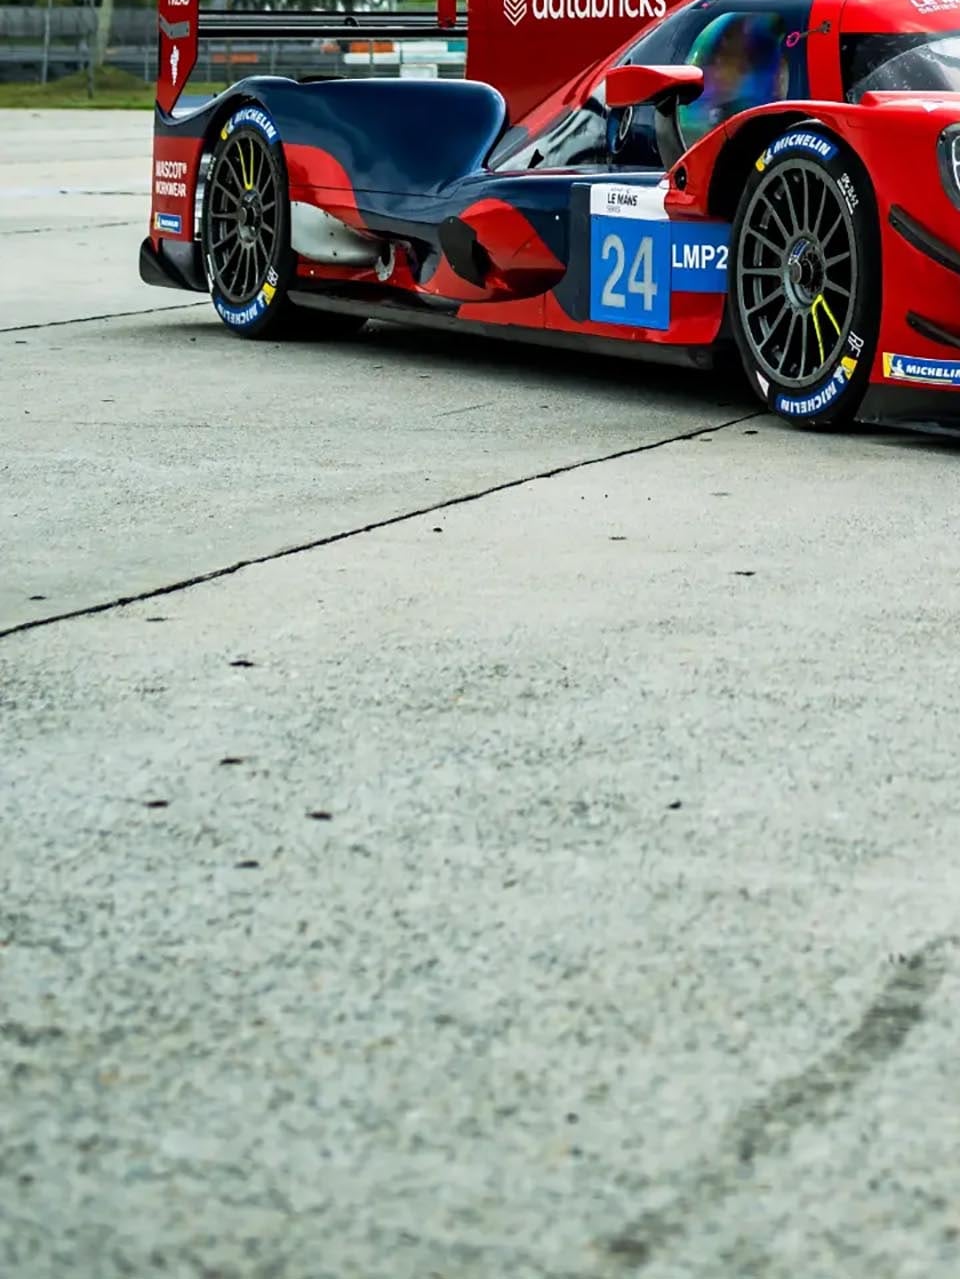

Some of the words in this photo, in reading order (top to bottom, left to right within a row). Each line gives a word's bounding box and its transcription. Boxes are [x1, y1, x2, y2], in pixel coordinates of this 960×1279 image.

[234, 108, 277, 139] MICHELIN
[773, 133, 832, 157] MICHELIN
[607, 193, 617, 205] LE
[617, 194, 638, 207] MANS
[671, 244, 729, 270] LMP2
[601, 233, 657, 311] 24
[217, 303, 258, 325] MICHELIN
[780, 380, 837, 415] MICHELIN
